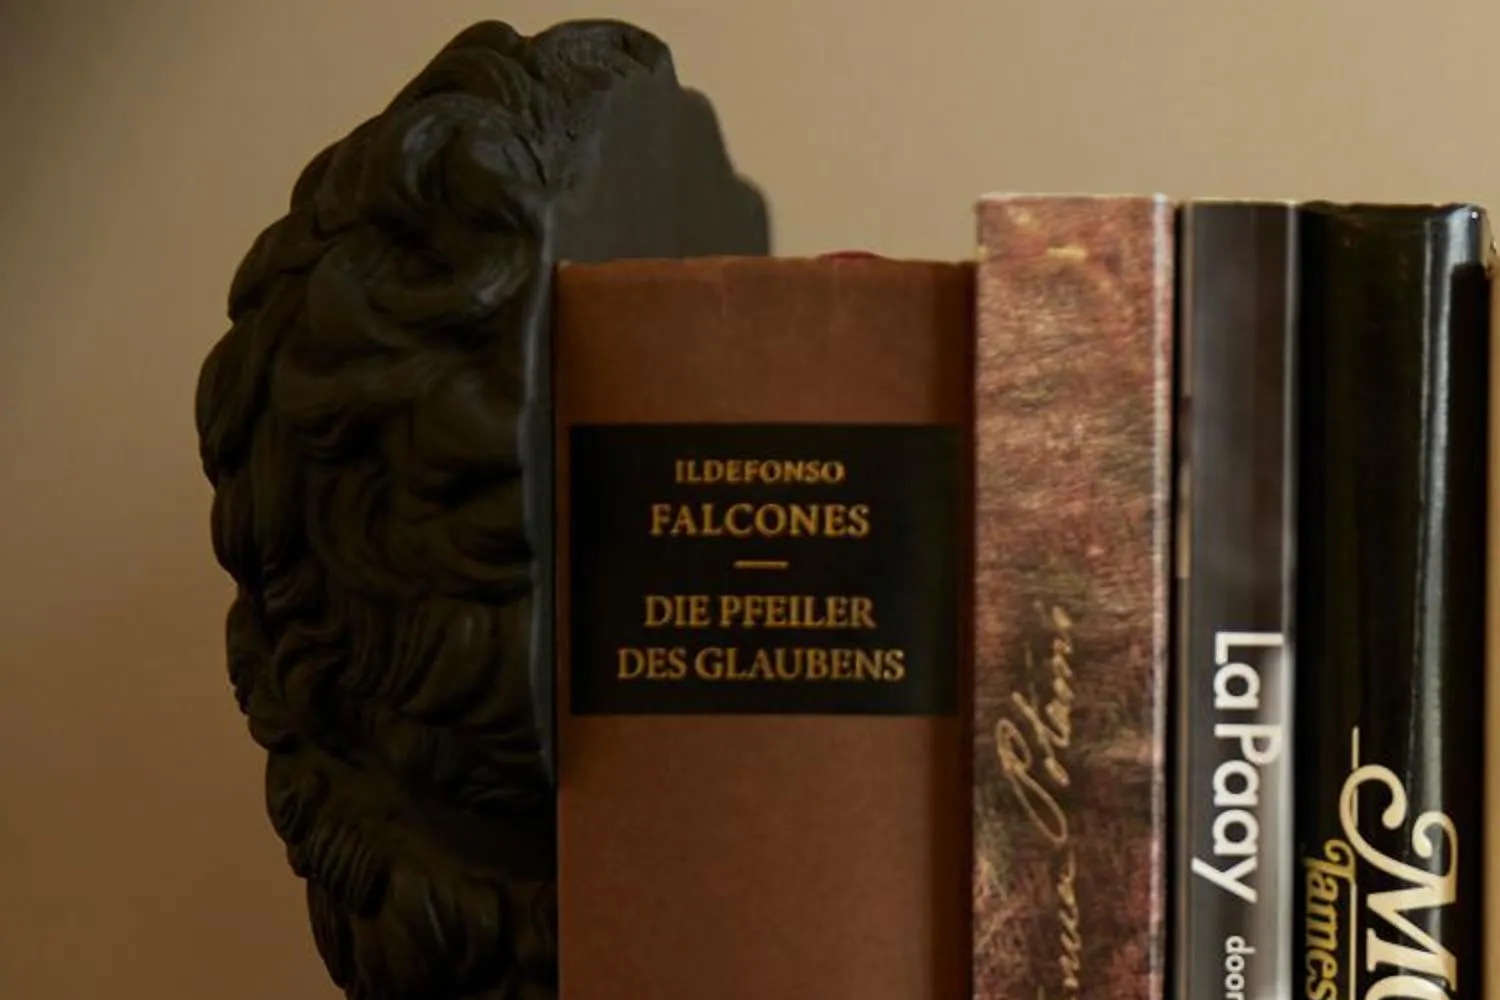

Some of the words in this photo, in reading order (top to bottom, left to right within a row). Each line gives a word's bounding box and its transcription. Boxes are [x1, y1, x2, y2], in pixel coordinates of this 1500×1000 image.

[675, 459, 846, 485] ILDEFONSO
[649, 503, 870, 538] FALCONES
[643, 595, 711, 628] DIE
[719, 595, 877, 629] PFEILER
[617, 648, 687, 680] DES
[694, 648, 905, 681] GLAUBENS
[1214, 631, 1286, 710] La
[1191, 722, 1282, 904] Paay
